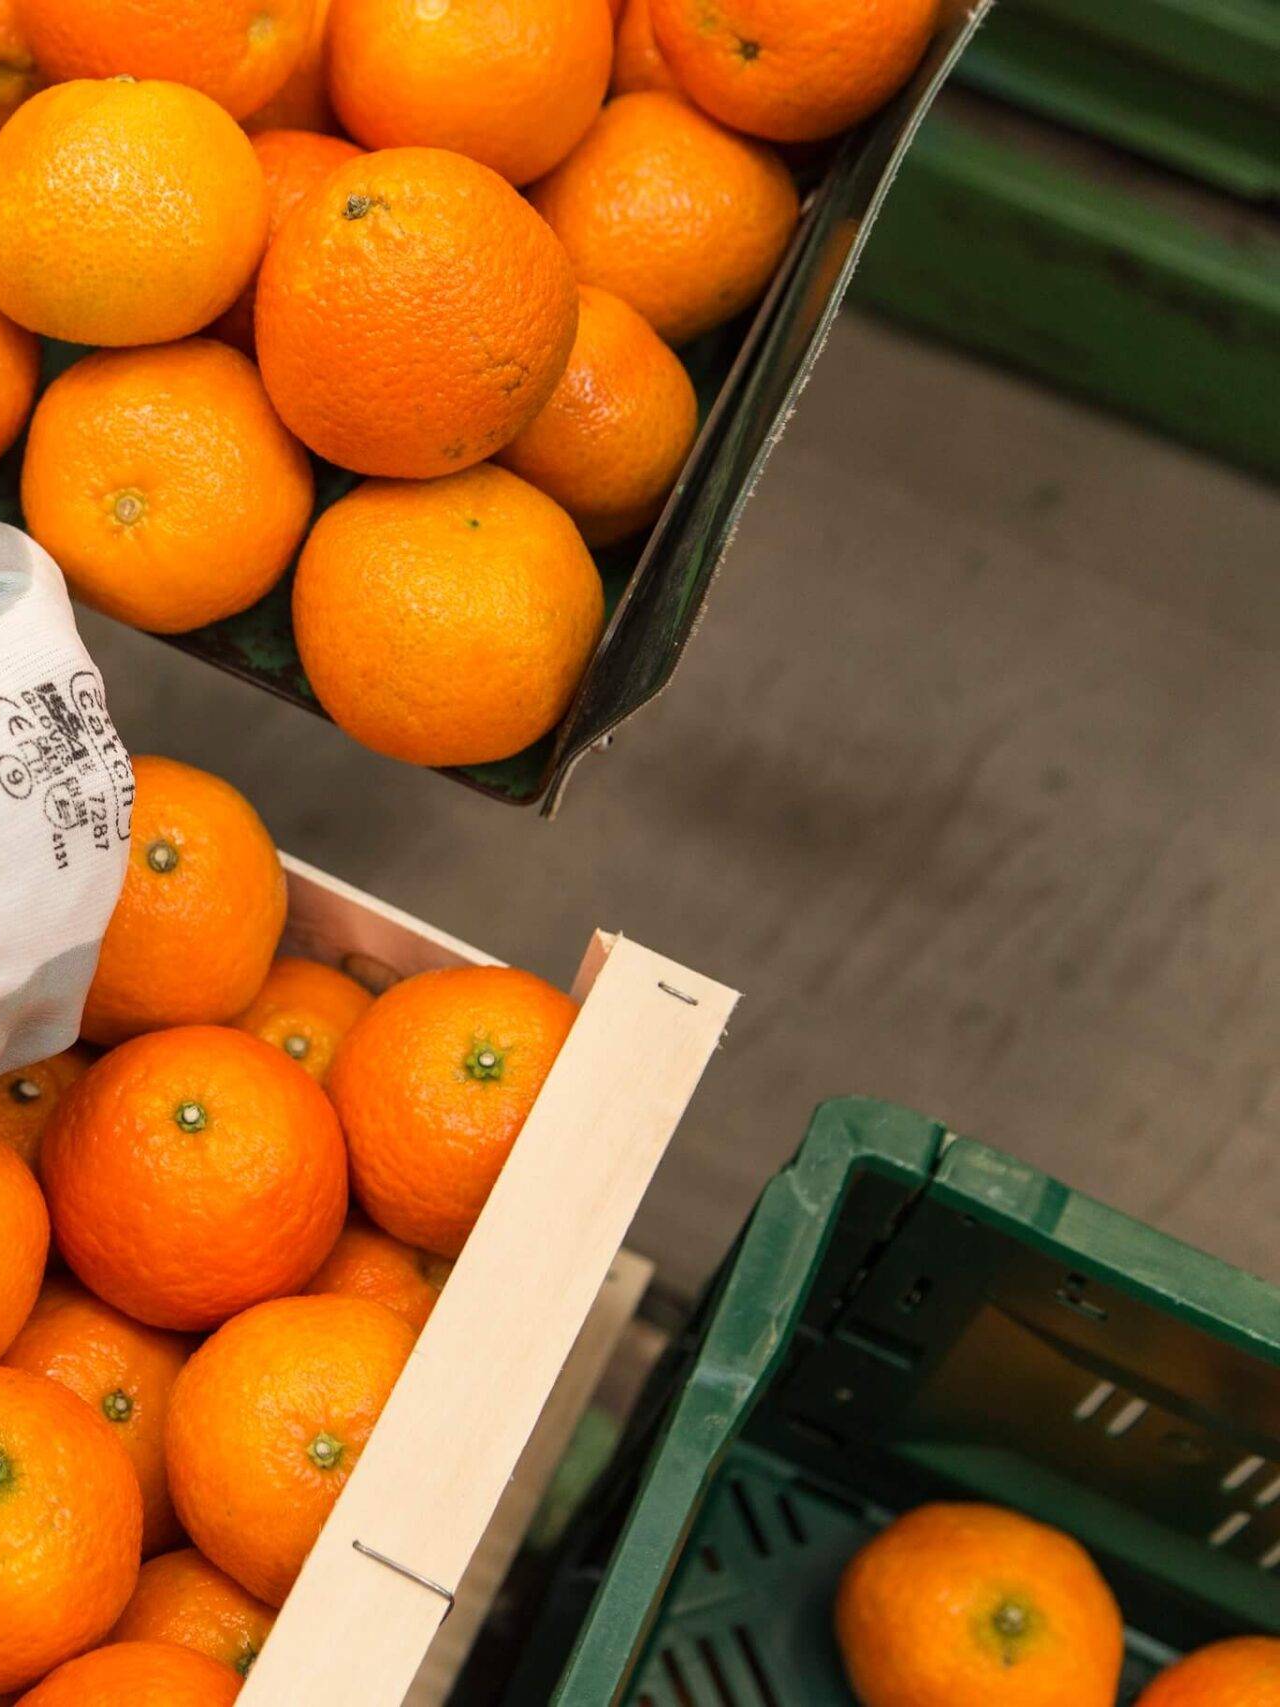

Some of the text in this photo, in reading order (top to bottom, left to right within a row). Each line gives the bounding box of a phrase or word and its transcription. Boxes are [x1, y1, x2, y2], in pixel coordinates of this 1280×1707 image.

[21, 691, 73, 767] GLOVES
[7, 768, 24, 785] 9
[89, 792, 110, 851] 7287
